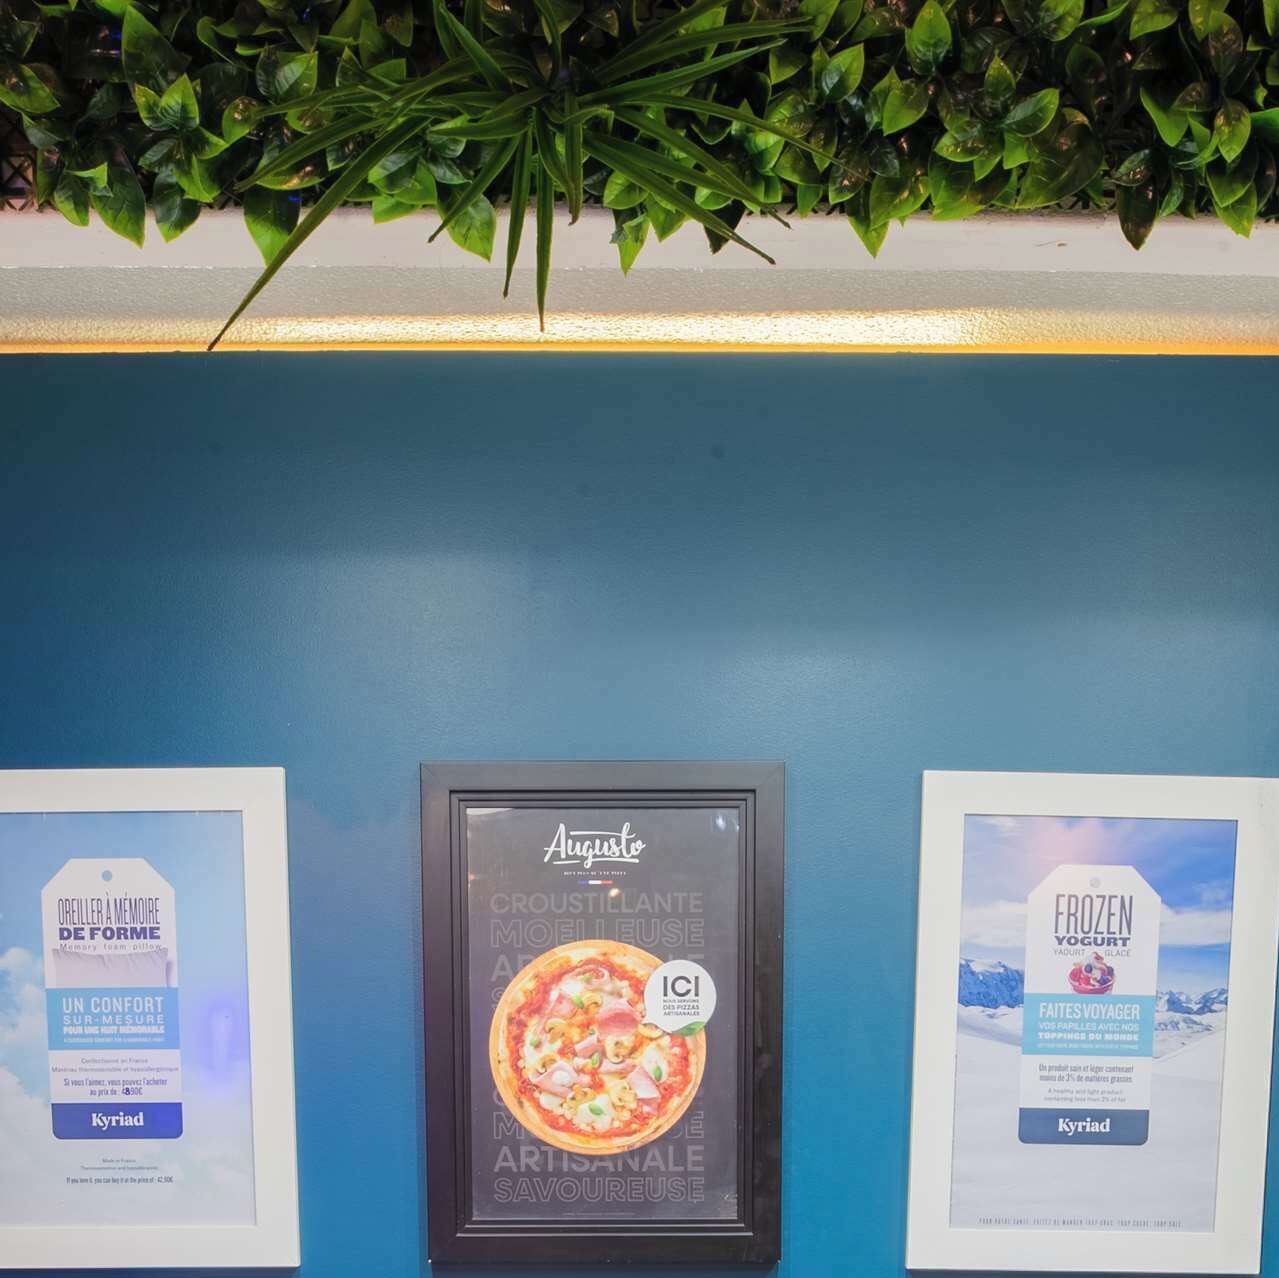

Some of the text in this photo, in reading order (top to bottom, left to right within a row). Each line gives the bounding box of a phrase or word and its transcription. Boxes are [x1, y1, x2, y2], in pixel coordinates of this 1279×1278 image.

[543, 822, 646, 868] Augusto
[58, 892, 161, 926] OREILLER À MÉMOIRE
[490, 892, 704, 913] CROUSTILLANTE
[1054, 893, 1134, 935] FROZEN
[59, 926, 161, 940] DE FORME
[1054, 935, 1131, 947] YOGURT
[59, 943, 97, 951] Memory
[132, 943, 162, 951] pillow
[663, 976, 700, 997] ICI
[62, 996, 164, 1013] UN CONFORT
[1039, 1002, 1140, 1020] FAITES VOYAGER
[63, 1014, 165, 1025] SUR-MESURE
[91, 1112, 144, 1131] Kyriad
[1057, 1117, 1111, 1136] Kyriad
[494, 1146, 705, 1173] ARTISANALE
[494, 1177, 705, 1202] SAVOUREUSE
